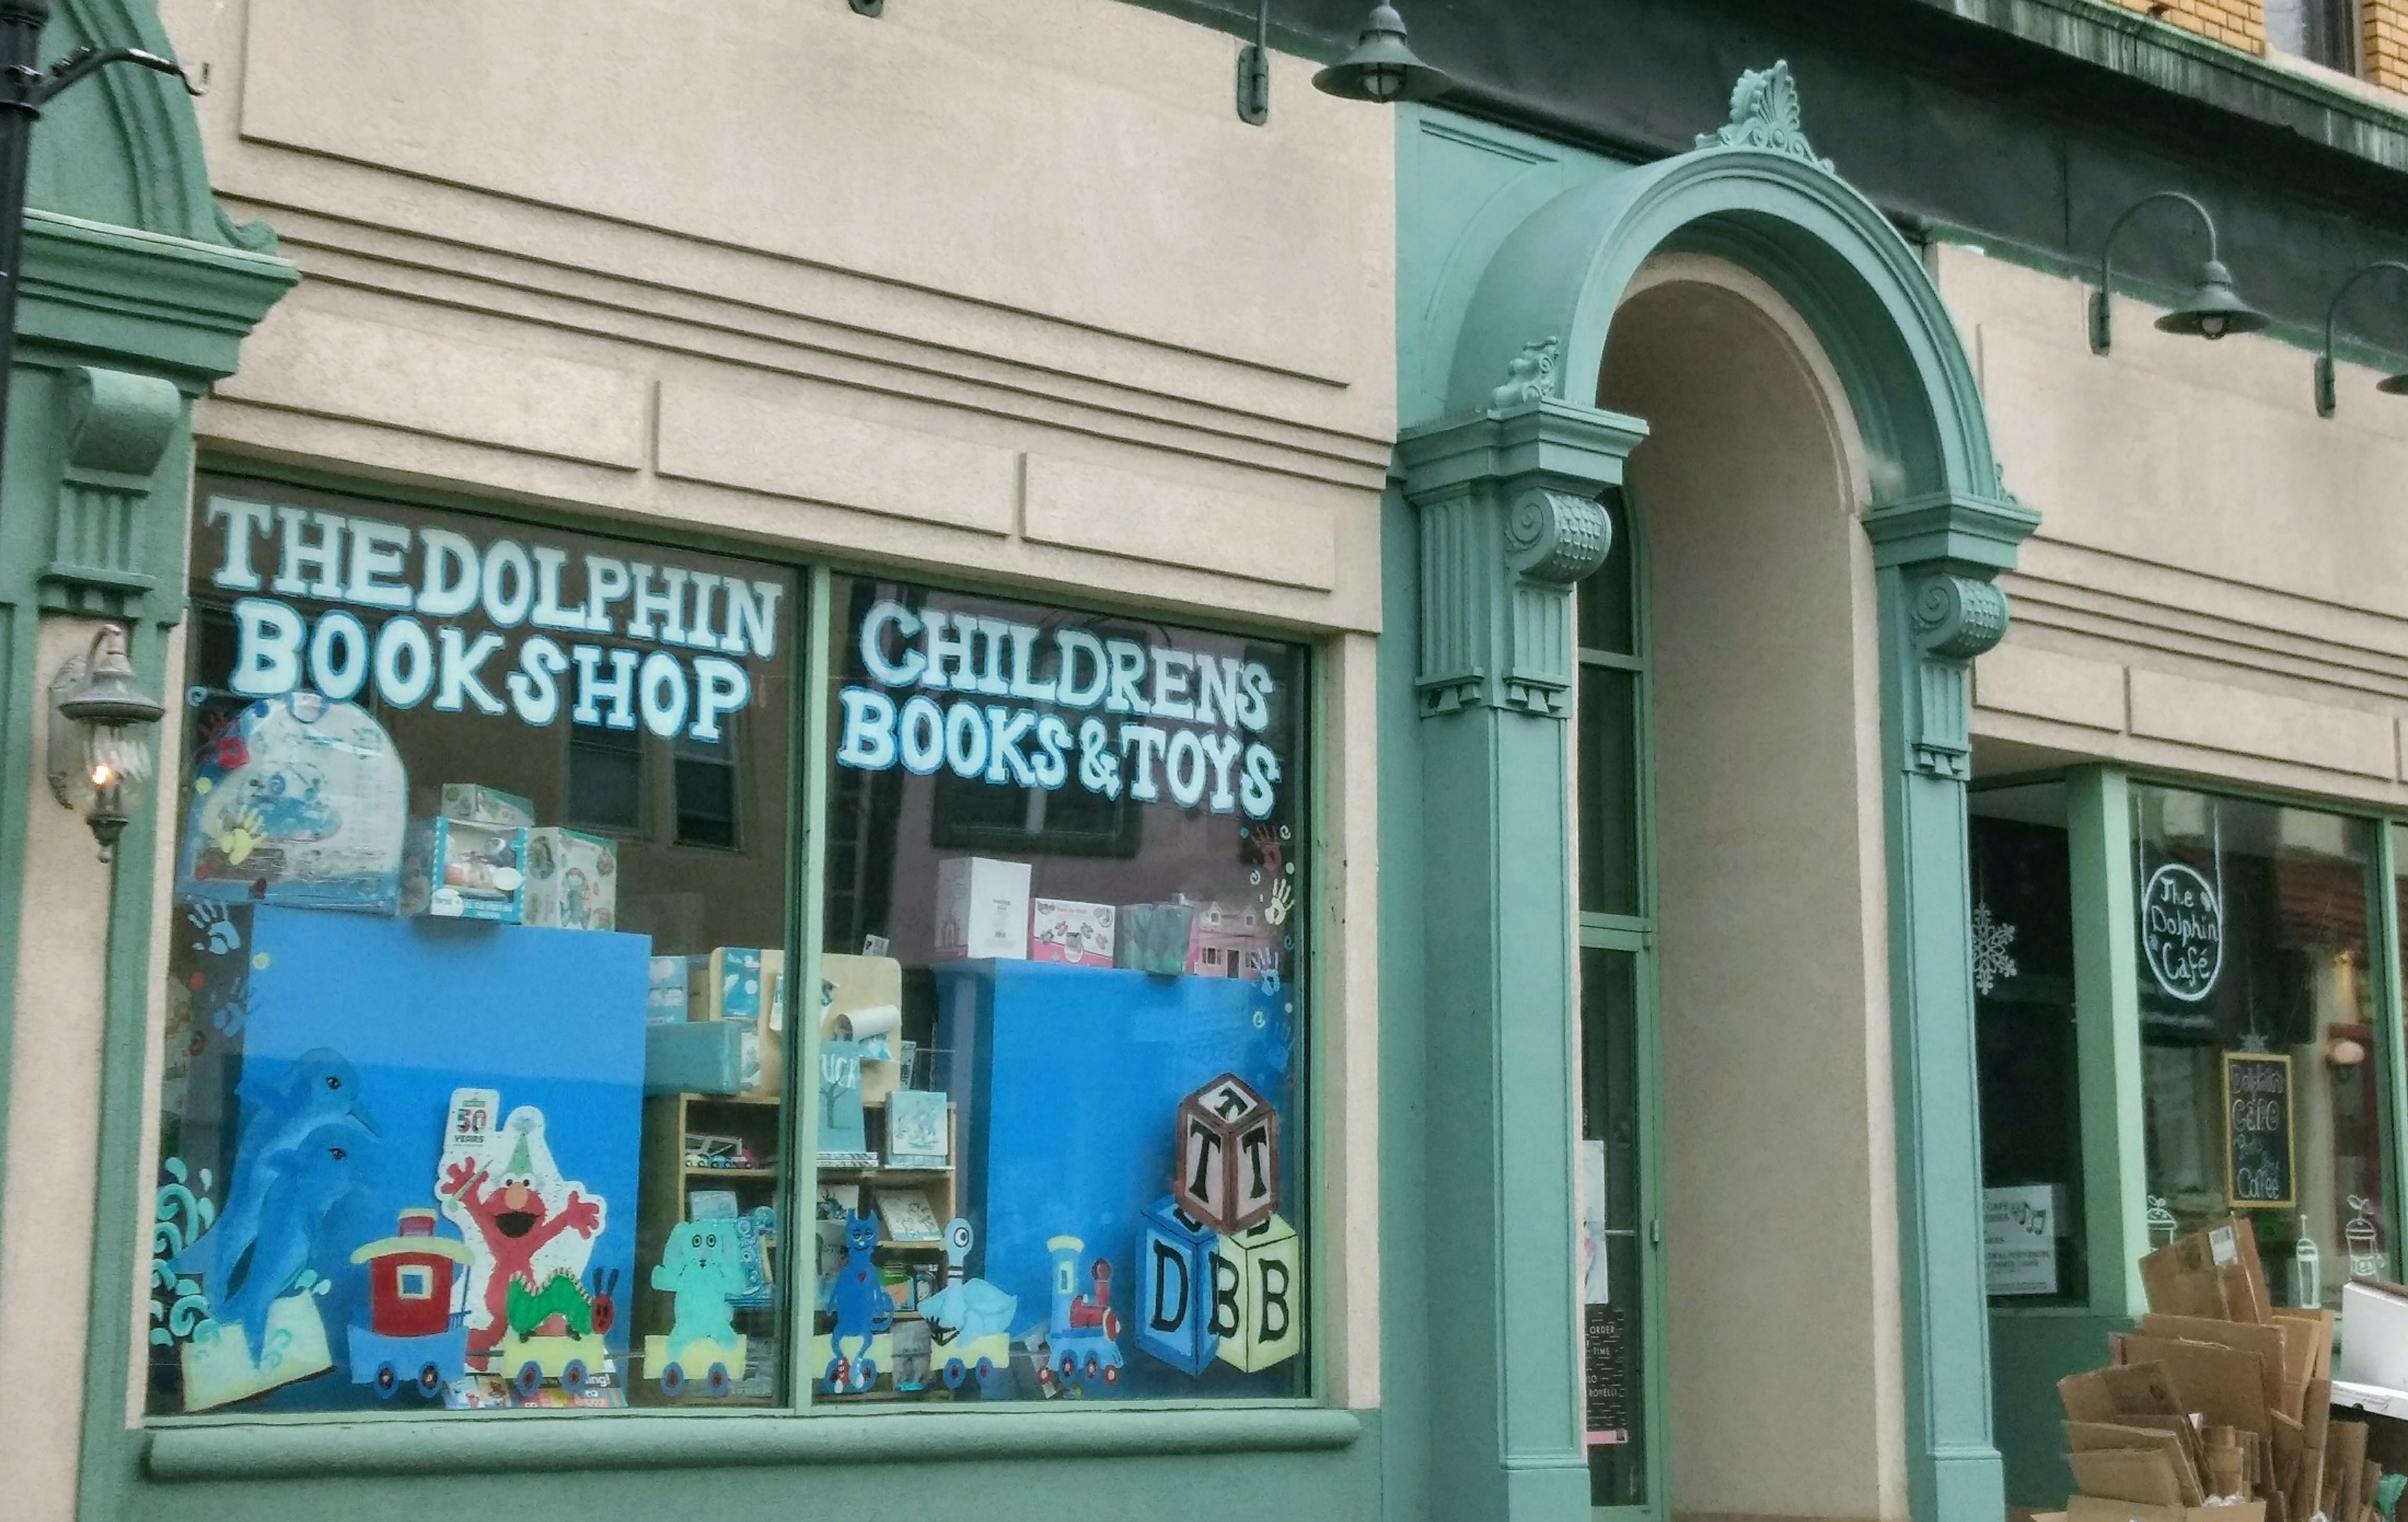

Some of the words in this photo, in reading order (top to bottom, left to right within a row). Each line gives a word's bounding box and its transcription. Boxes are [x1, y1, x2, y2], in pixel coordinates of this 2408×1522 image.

[207, 495, 412, 609] THE
[416, 527, 782, 660] DOLPHIN
[859, 599, 1275, 733] CHILDRENS
[2151, 905, 2219, 948] Dolphin
[2160, 877, 2194, 908] The
